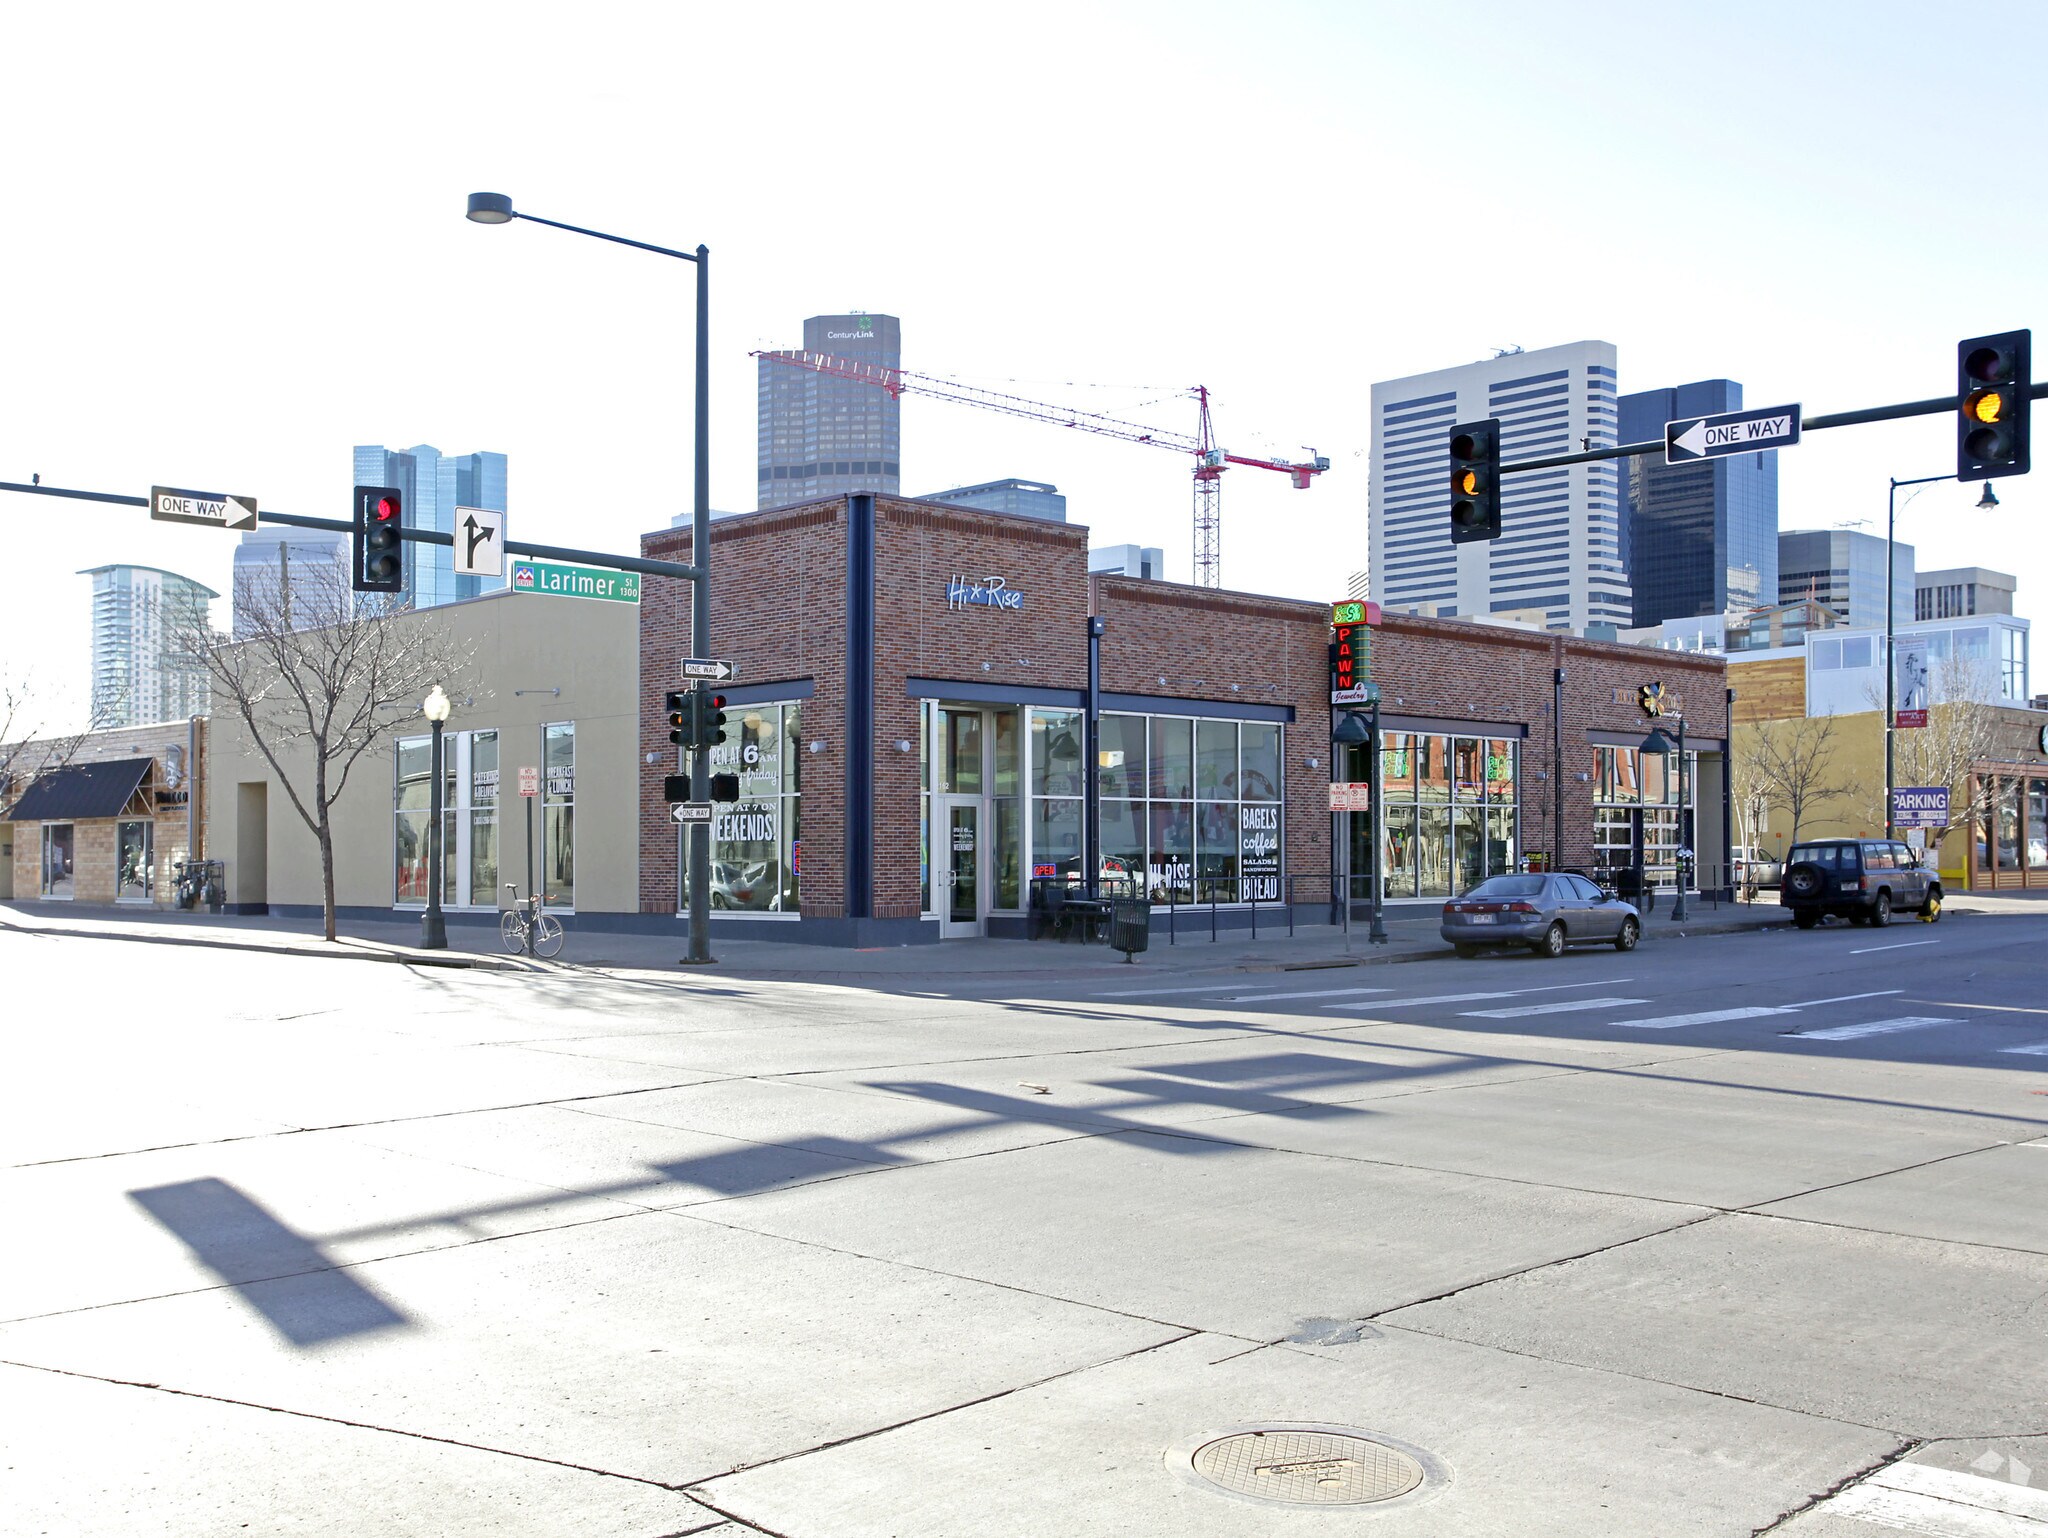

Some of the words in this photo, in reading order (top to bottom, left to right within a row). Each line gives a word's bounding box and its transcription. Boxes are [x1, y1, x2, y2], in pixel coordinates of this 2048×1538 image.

[827, 331, 874, 339] CenturyLink
[1705, 425, 1740, 445] ONE
[1747, 418, 1785, 438] WAY
[162, 497, 191, 513] ONE
[196, 501, 226, 517] WAY
[541, 569, 615, 596] Larimer
[625, 578, 633, 587] St
[949, 574, 968, 610] Hi
[982, 576, 1021, 610] Rise
[620, 587, 638, 598] 1300
[1337, 627, 1353, 688] PAWN
[687, 664, 701, 673] ONE
[703, 665, 718, 674] WAY
[1335, 691, 1365, 702] Jewelry
[730, 746, 740, 765] AT
[713, 803, 734, 812] PEN
[736, 803, 750, 811] AT
[752, 803, 759, 811] 7
[761, 802, 777, 811] ON
[1893, 794, 1946, 809] PARKING
[682, 809, 694, 817] ONE
[696, 809, 709, 817] WAY
[1243, 808, 1277, 829] BAGELS
[709, 814, 777, 841] WEEKENDS!
[1243, 832, 1276, 857] coffee
[1034, 866, 1055, 876] OPEN
[1243, 876, 1277, 900] BREAD
